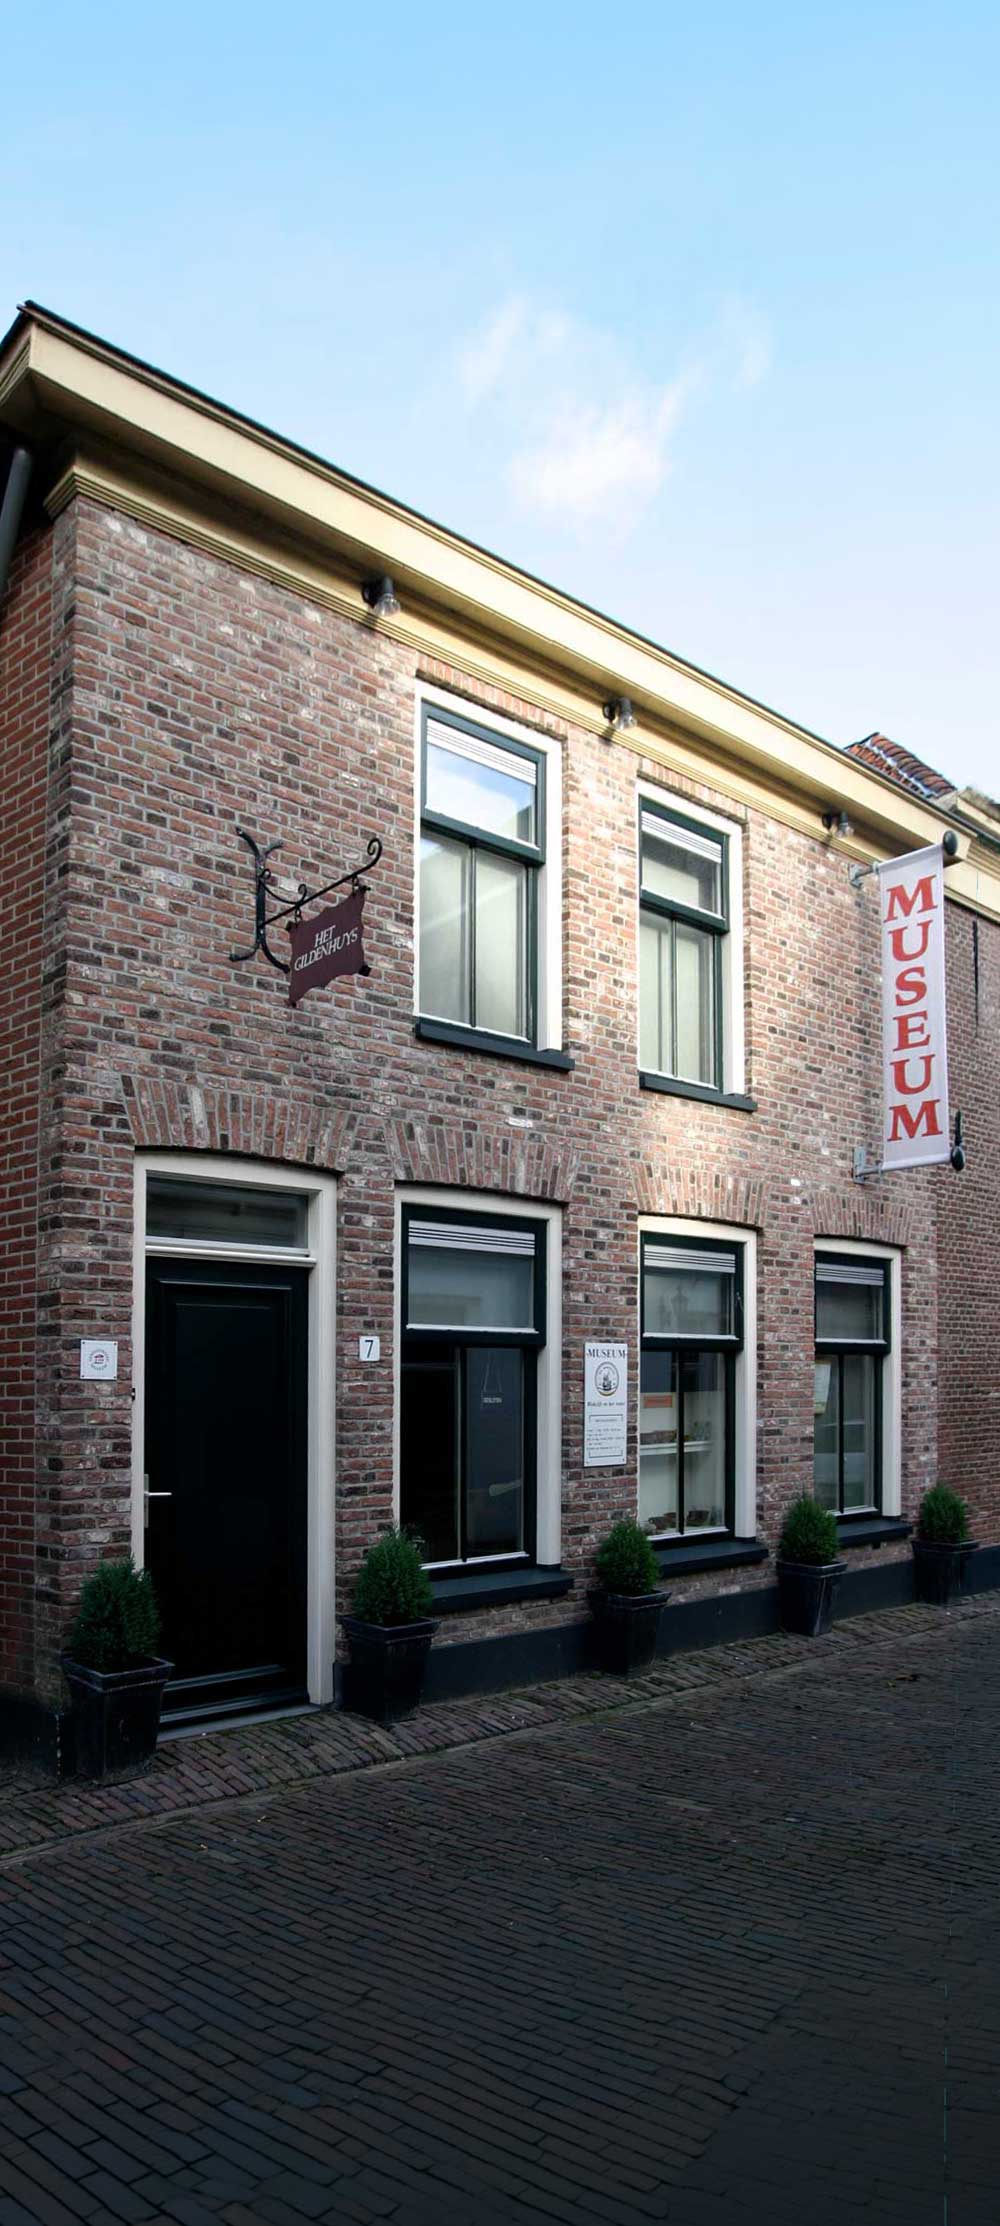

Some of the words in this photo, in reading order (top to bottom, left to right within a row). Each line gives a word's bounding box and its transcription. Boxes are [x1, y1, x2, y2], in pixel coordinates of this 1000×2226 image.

[314, 925, 336, 948] HET
[294, 927, 359, 971] GILDENHUYS
[884, 875, 943, 1142] MUSEUM
[365, 1339, 374, 1359] 7
[587, 1348, 626, 1359] MUSEUM
